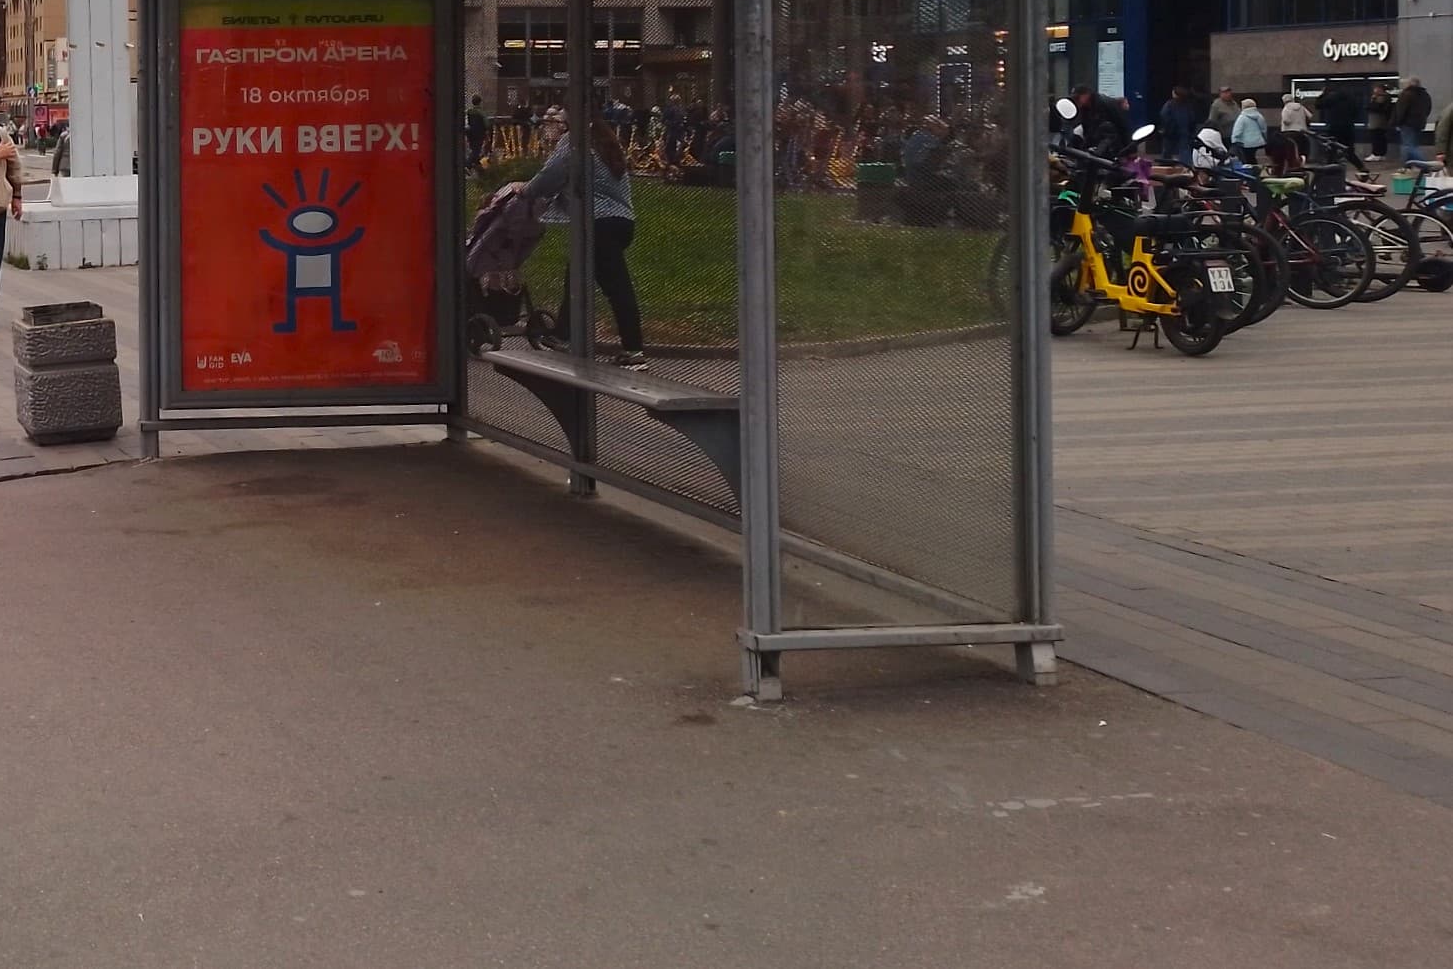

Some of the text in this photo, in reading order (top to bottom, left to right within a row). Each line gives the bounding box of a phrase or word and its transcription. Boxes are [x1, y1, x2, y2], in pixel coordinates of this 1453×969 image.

[222, 15, 280, 25] БИЛЕТЫ
[196, 45, 408, 63] ГАЗПРОМ АРЕНА
[1322, 38, 1389, 61] буквоед
[240, 85, 370, 105] 18 октября
[192, 127, 283, 155] РУКИ
